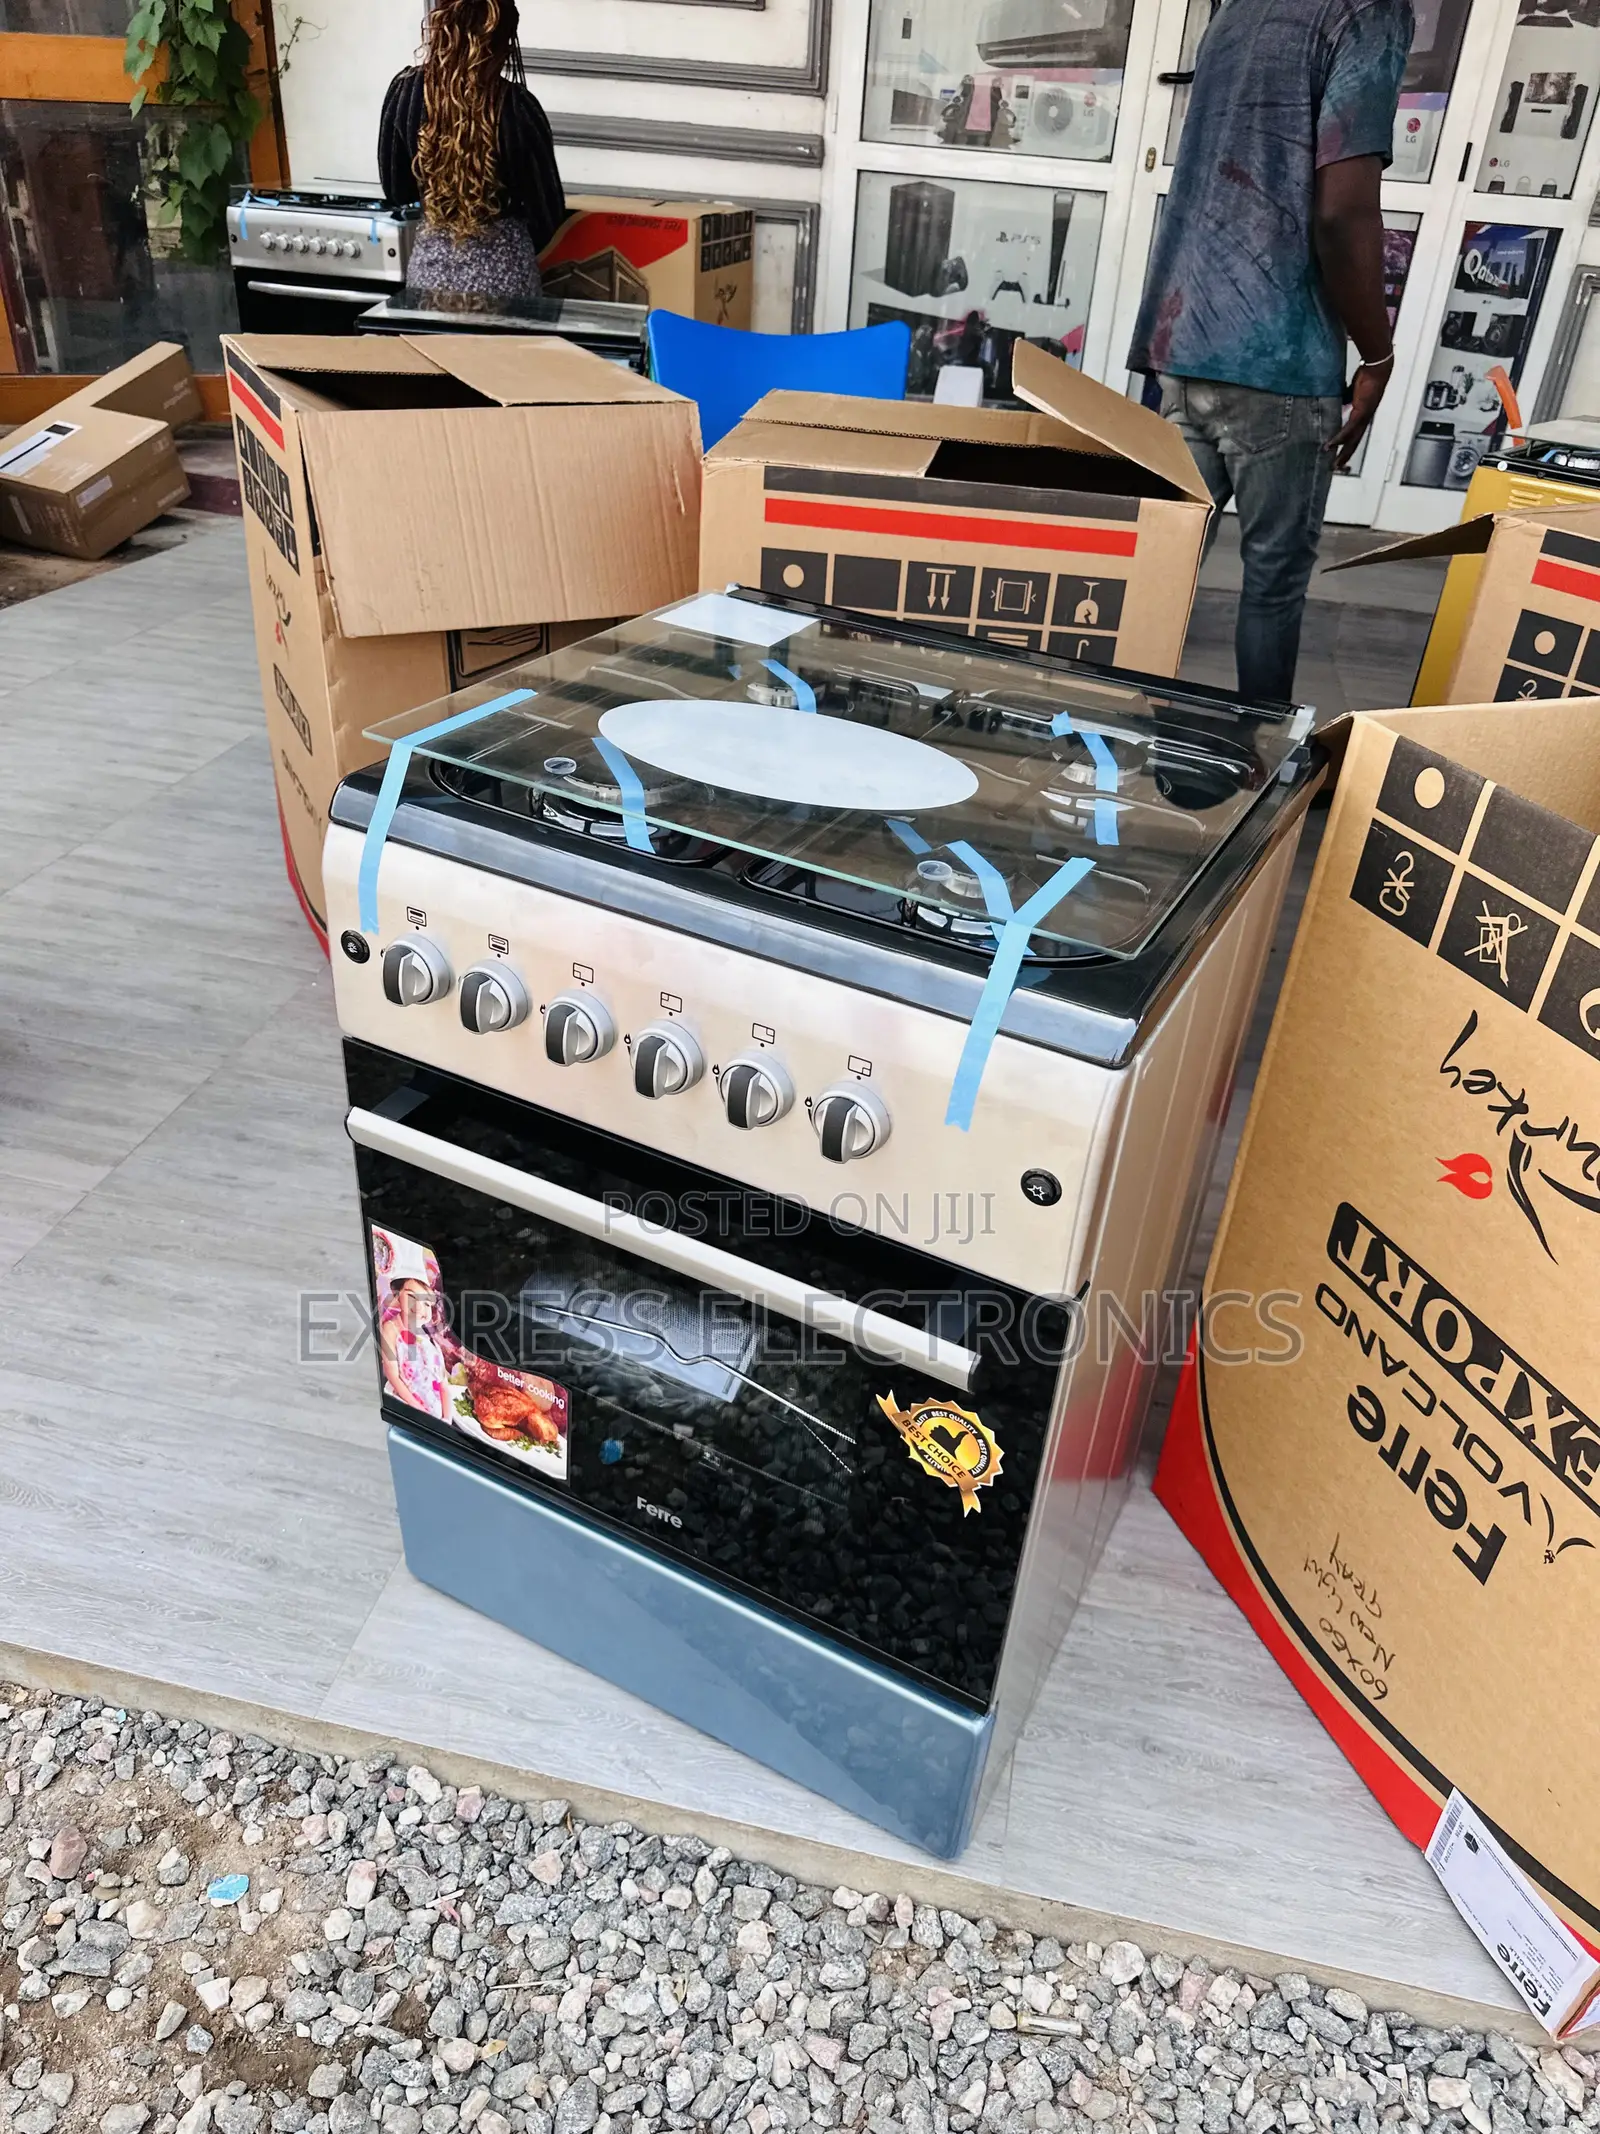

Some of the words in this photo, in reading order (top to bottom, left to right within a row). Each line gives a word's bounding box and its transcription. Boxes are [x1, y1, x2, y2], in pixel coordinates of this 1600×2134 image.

[1405, 135, 1417, 144] LG
[1499, 159, 1510, 168] LG
[1010, 233, 1041, 245] PS5
[1336, 1219, 1600, 1487] EXPORT
[497, 1367, 525, 1388] better
[527, 1382, 565, 1409] cooking
[1315, 1282, 1532, 1526] VOLCANO
[948, 1413, 978, 1435] QUALITY
[902, 1419, 928, 1443] BEST
[927, 1442, 967, 1478] CHOICE
[1347, 1384, 1508, 1586] Ferre
[636, 1495, 683, 1529] Ferre
[1495, 1942, 1552, 2017] Ferre
